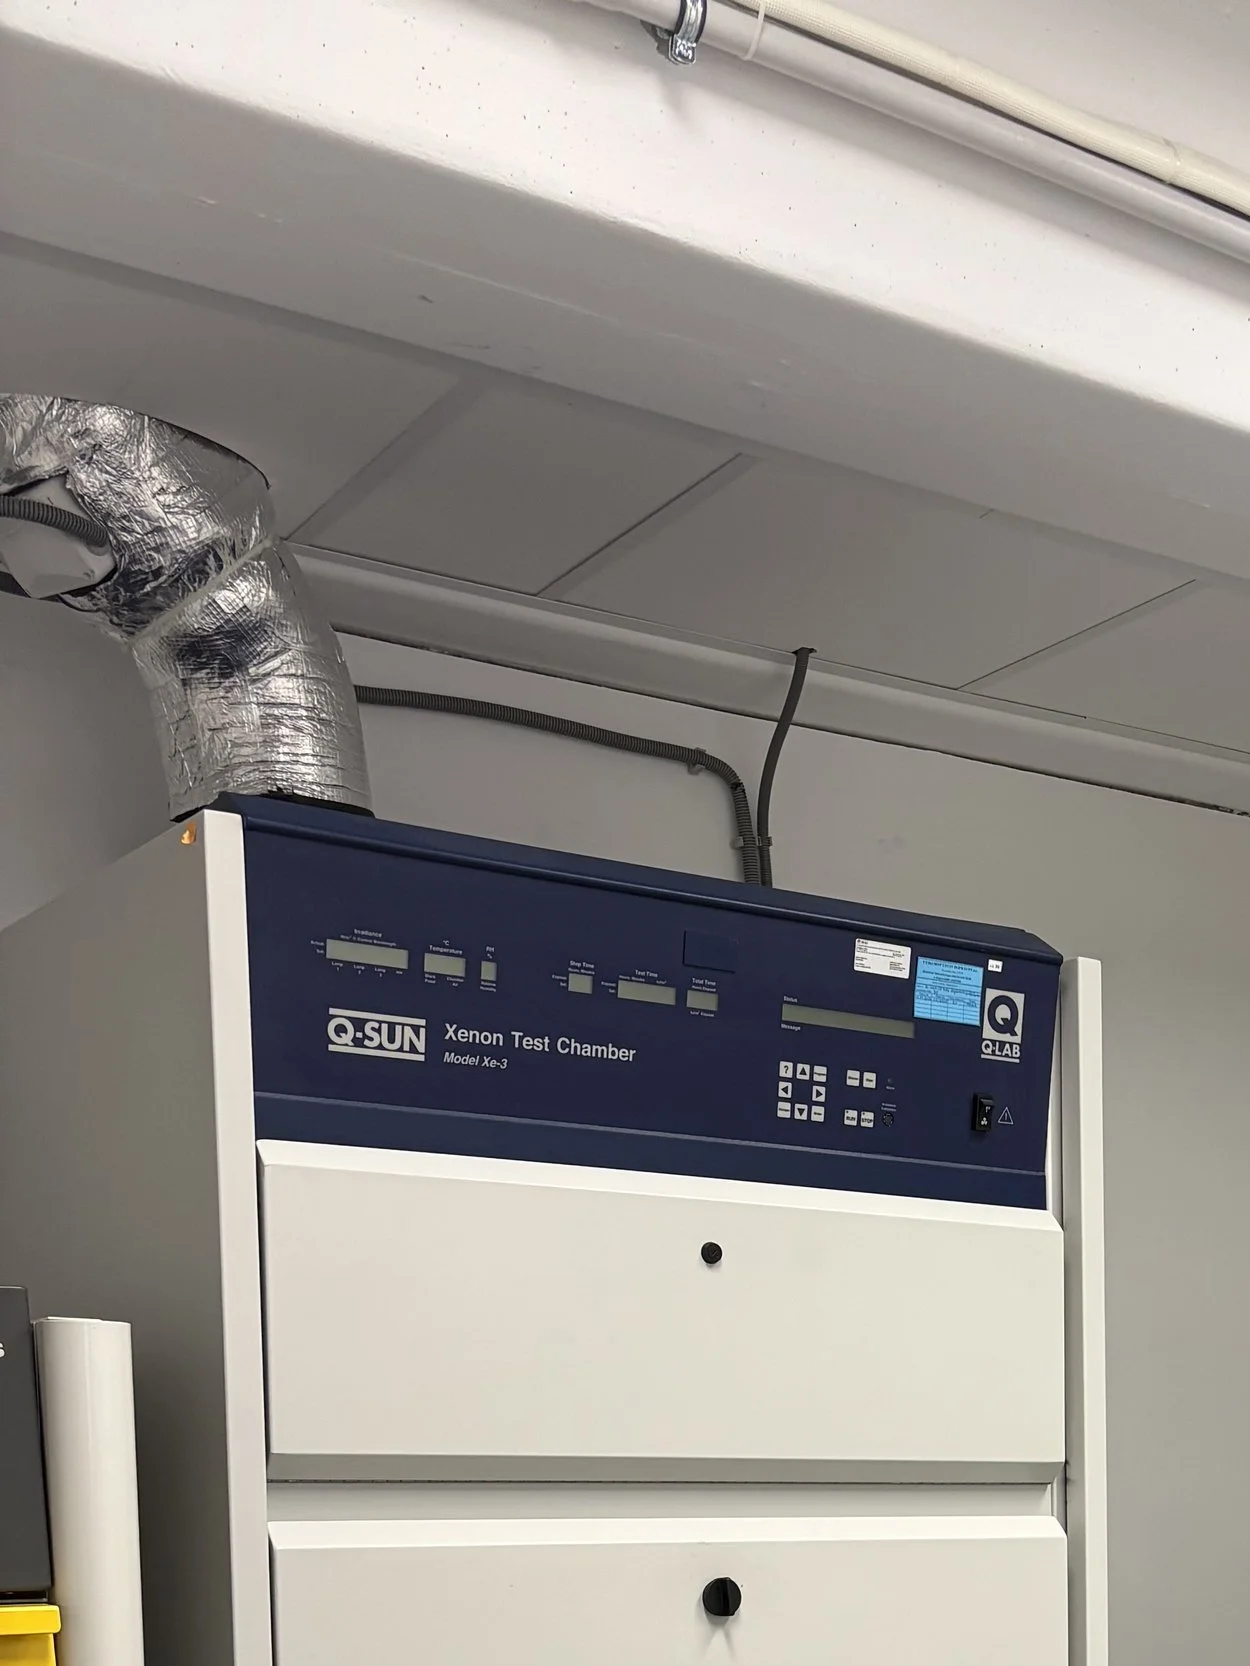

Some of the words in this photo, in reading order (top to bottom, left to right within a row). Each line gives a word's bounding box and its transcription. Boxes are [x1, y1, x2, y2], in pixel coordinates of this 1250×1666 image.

[430, 944, 463, 956] Temperature
[988, 995, 1018, 1036] Q
[327, 1017, 426, 1053] Q-SUN
[444, 1023, 504, 1046] Xenon
[510, 1031, 550, 1052] Test
[556, 1036, 636, 1062] Chamber
[443, 1051, 480, 1066] Model
[482, 1056, 508, 1070] Xe-3
[784, 1065, 789, 1074] ?
